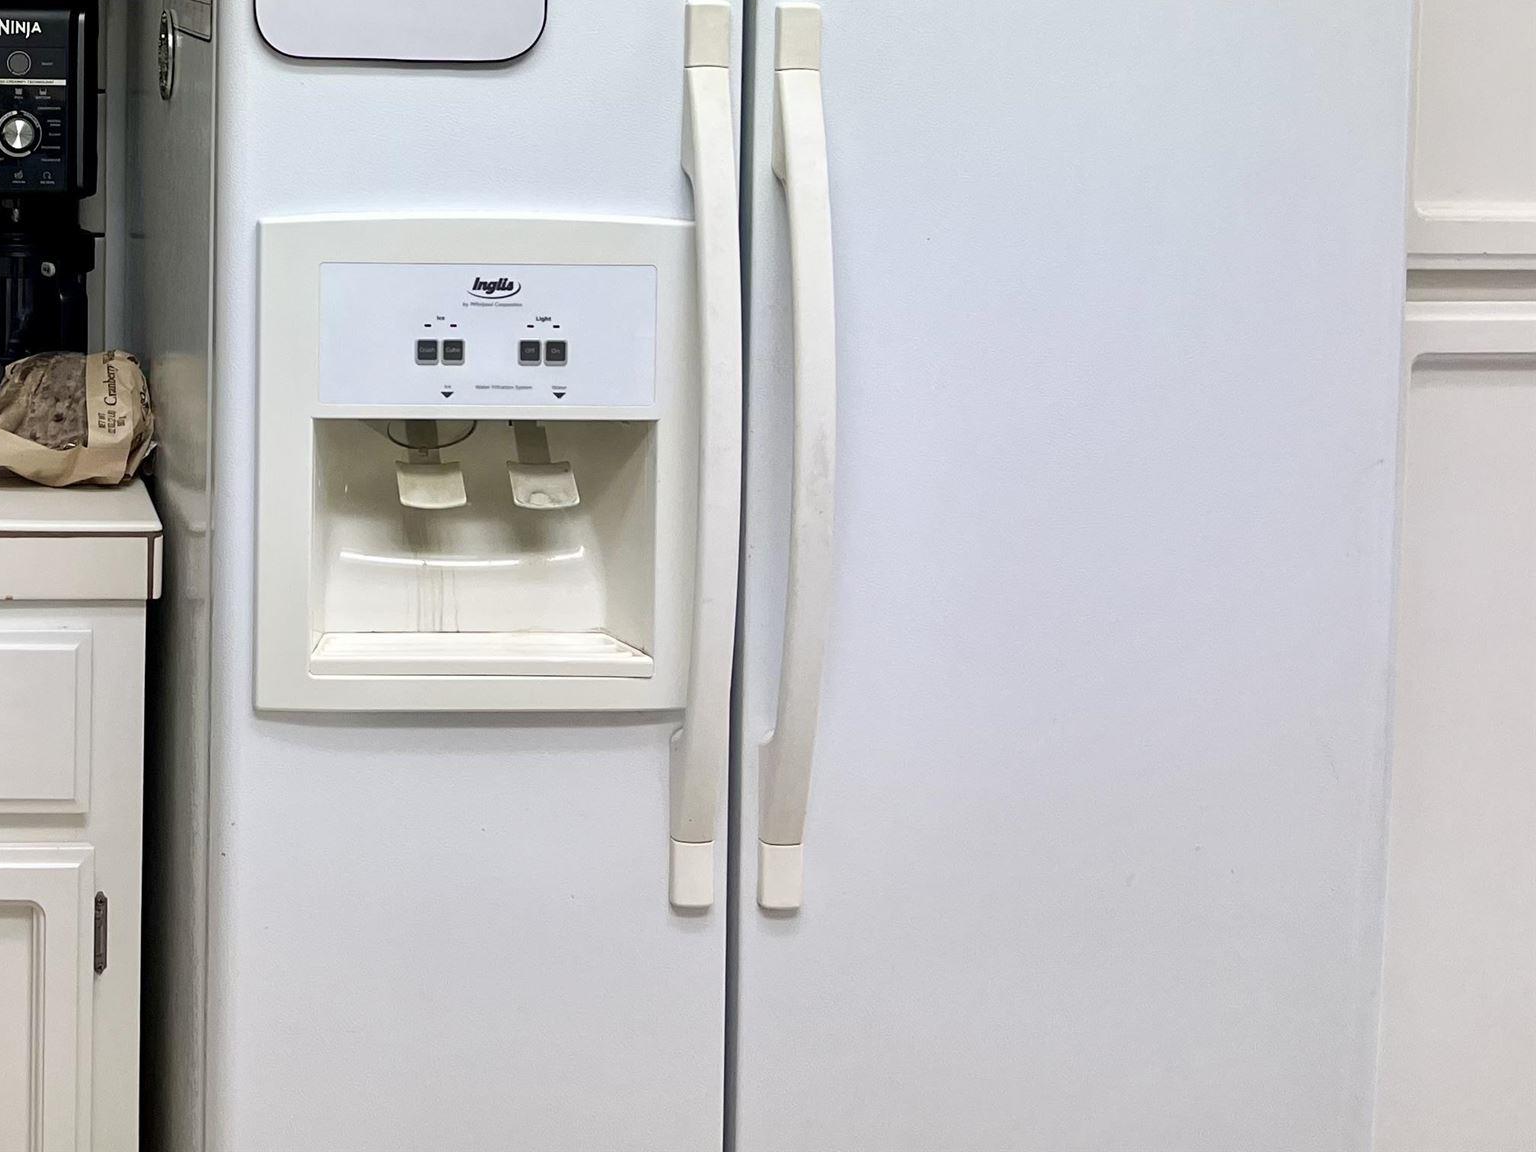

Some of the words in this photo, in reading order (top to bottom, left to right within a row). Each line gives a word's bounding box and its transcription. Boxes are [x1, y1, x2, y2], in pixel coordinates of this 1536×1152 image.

[472, 277, 514, 294] Inglis
[535, 315, 552, 323] Light
[103, 364, 119, 407] Cranberry
